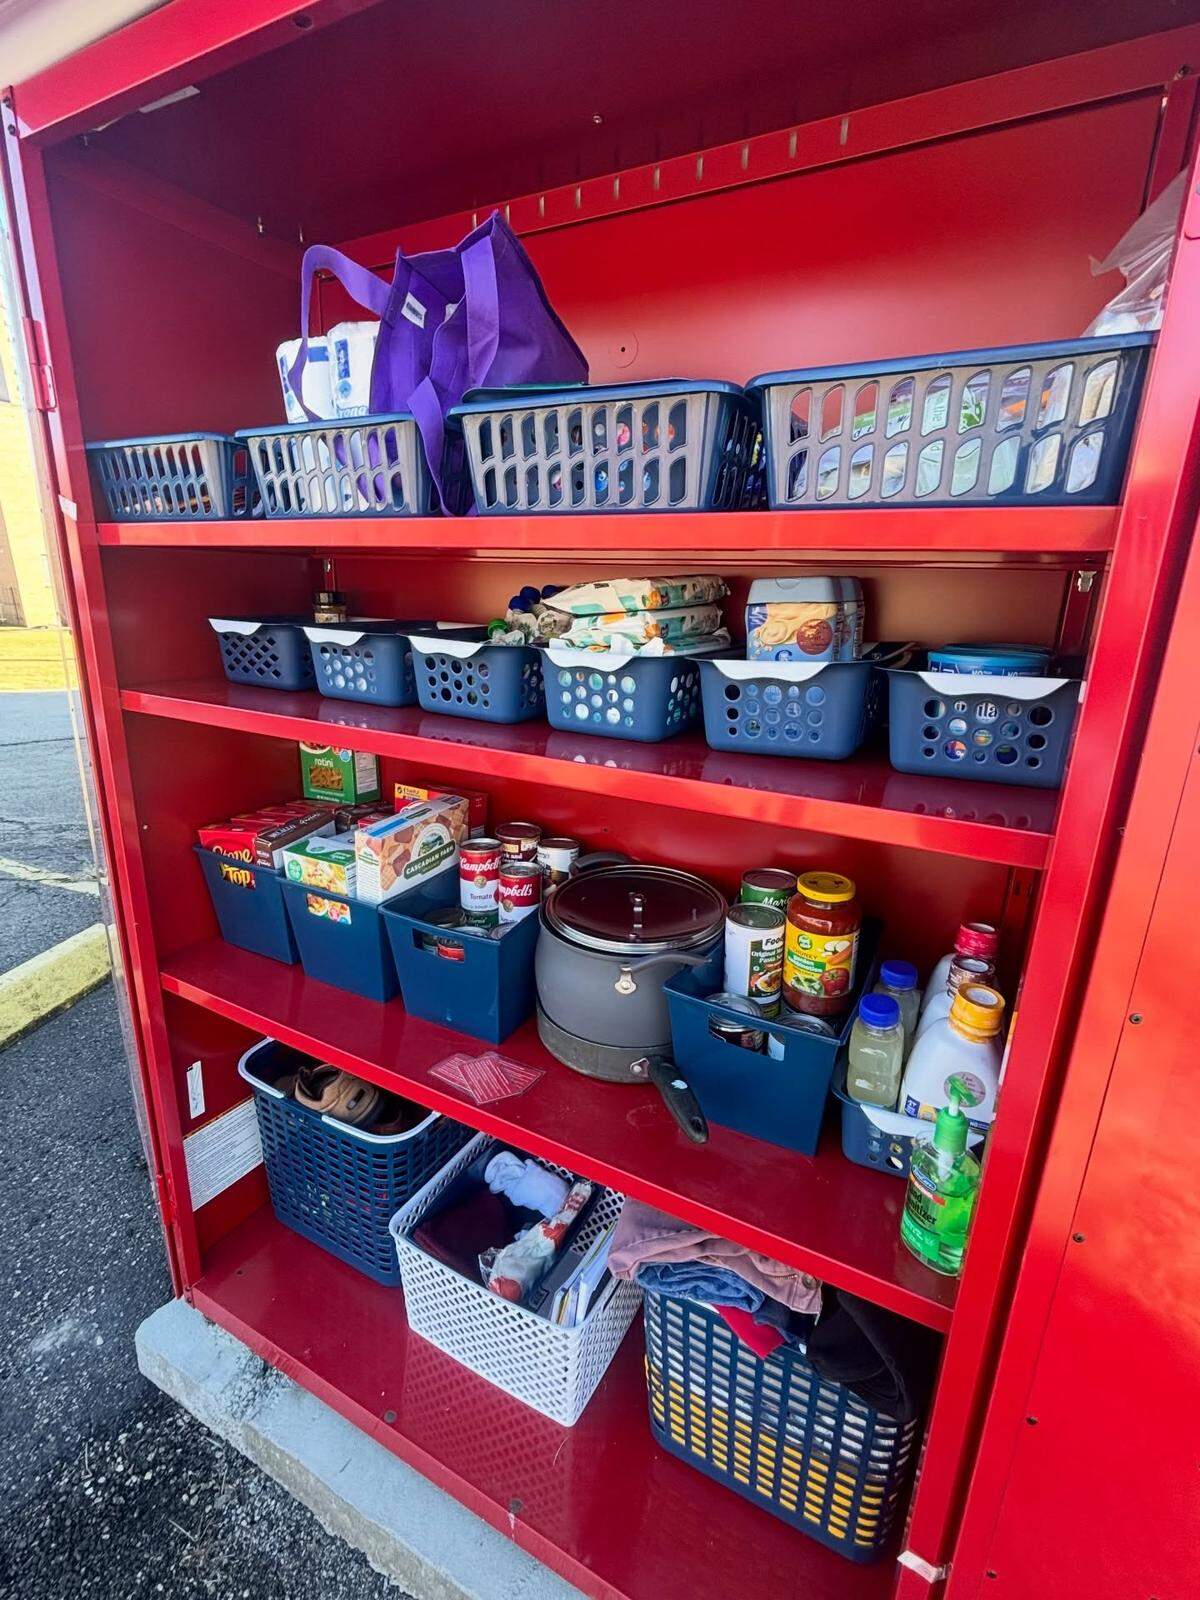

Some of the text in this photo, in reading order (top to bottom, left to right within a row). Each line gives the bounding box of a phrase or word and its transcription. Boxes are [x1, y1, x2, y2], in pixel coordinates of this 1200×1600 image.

[314, 757, 334, 767] rotini
[406, 851, 440, 875] CASCADIAN
[440, 842, 455, 859] FARM
